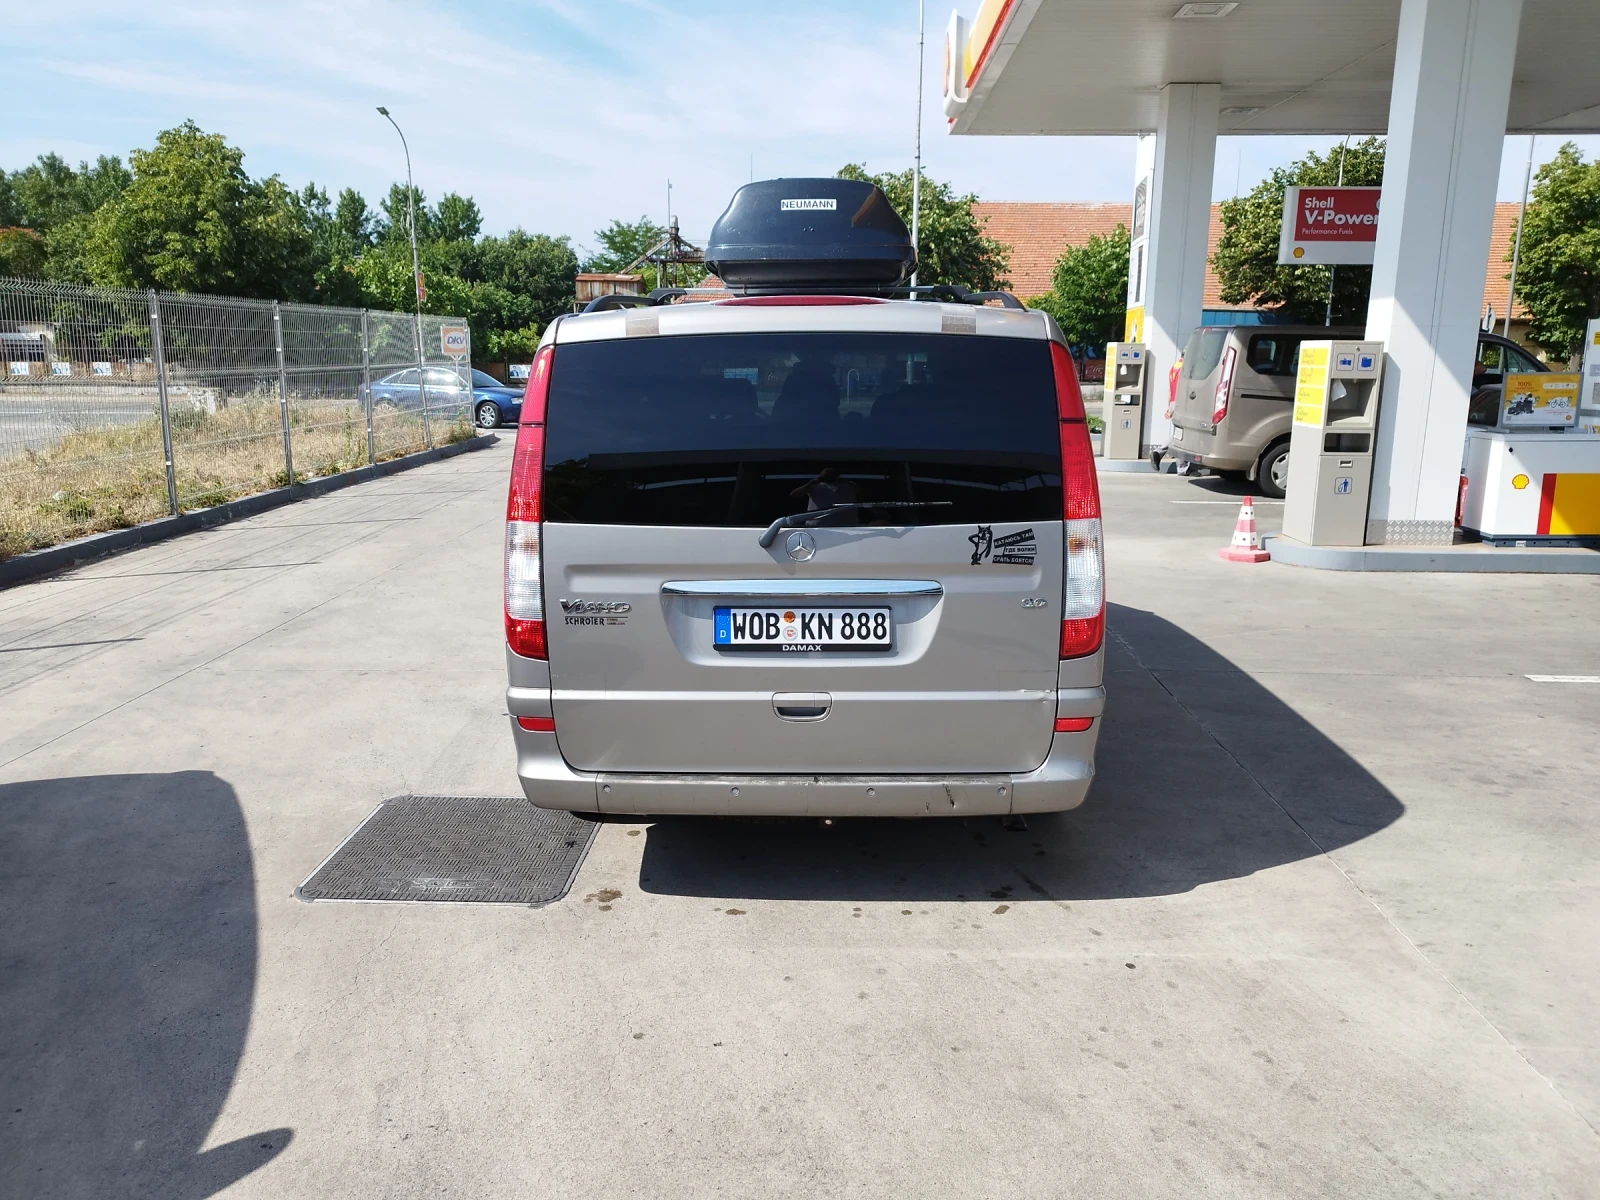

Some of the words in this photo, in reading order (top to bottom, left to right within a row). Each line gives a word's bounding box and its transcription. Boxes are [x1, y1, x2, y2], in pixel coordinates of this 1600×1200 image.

[782, 200, 833, 209] NEUMANN
[1304, 197, 1335, 209] Shell
[1301, 227, 1338, 235] Performance
[1338, 227, 1353, 235] Fuels
[446, 336, 465, 345] DKV
[995, 535, 1021, 546] КАТАЮСЬ
[719, 630, 727, 638] D
[732, 612, 781, 640] WOB
[801, 612, 833, 640] KN
[840, 612, 888, 640] 888
